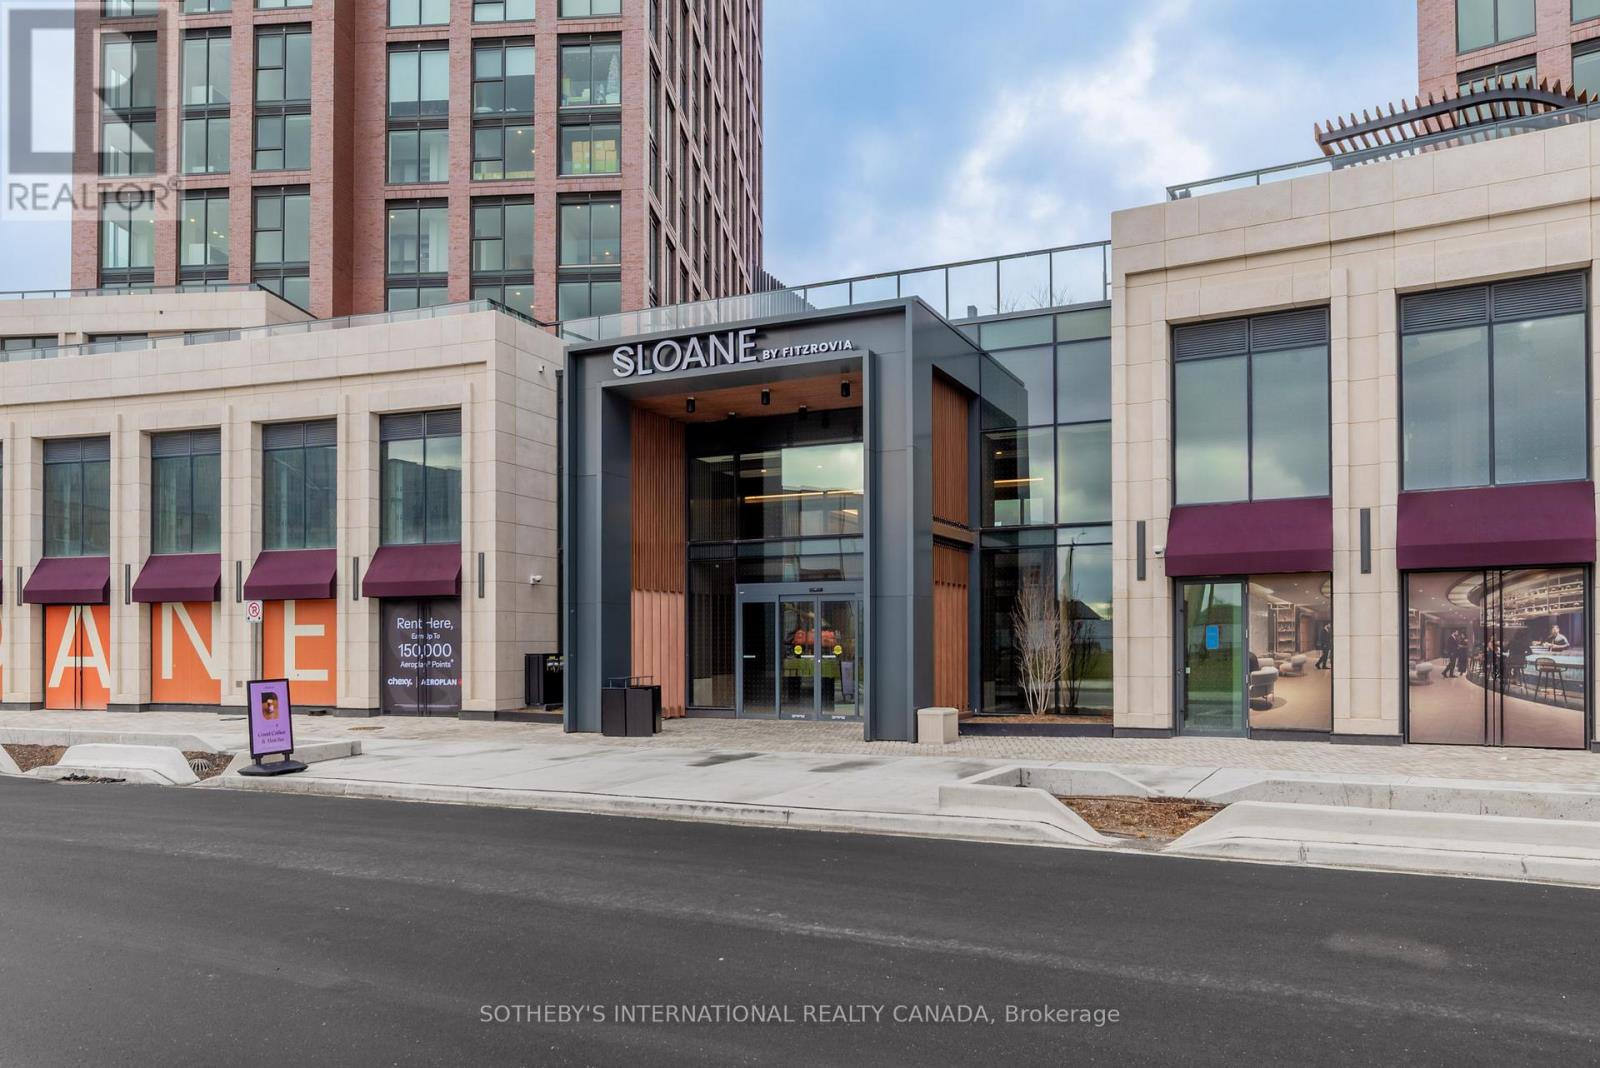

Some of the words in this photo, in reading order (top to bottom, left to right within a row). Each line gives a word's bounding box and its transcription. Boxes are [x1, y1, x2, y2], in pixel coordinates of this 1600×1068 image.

[612, 329, 757, 378] SLOANE
[762, 349, 780, 361] BY
[782, 339, 853, 358] FITZROVIA
[397, 618, 423, 630] Rent
[433, 632, 441, 640] To
[398, 643, 452, 660] 150,000
[421, 678, 457, 687] AEROPLAN
